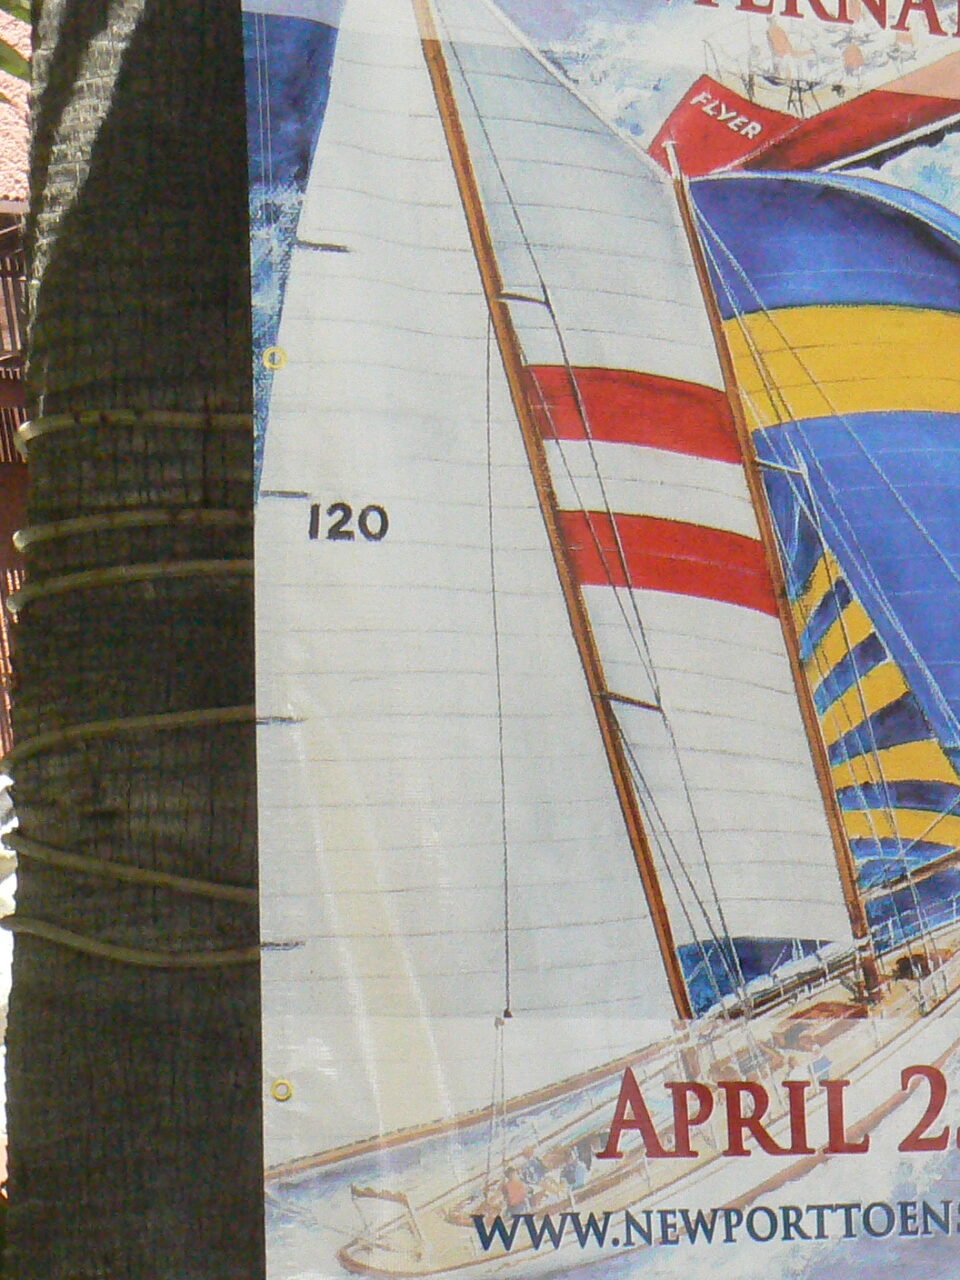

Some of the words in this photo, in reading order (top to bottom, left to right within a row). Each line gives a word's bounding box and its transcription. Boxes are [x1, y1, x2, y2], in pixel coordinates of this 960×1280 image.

[690, 91, 762, 140] FLYER
[308, 502, 389, 541] 120
[595, 1068, 870, 1160] APRIL
